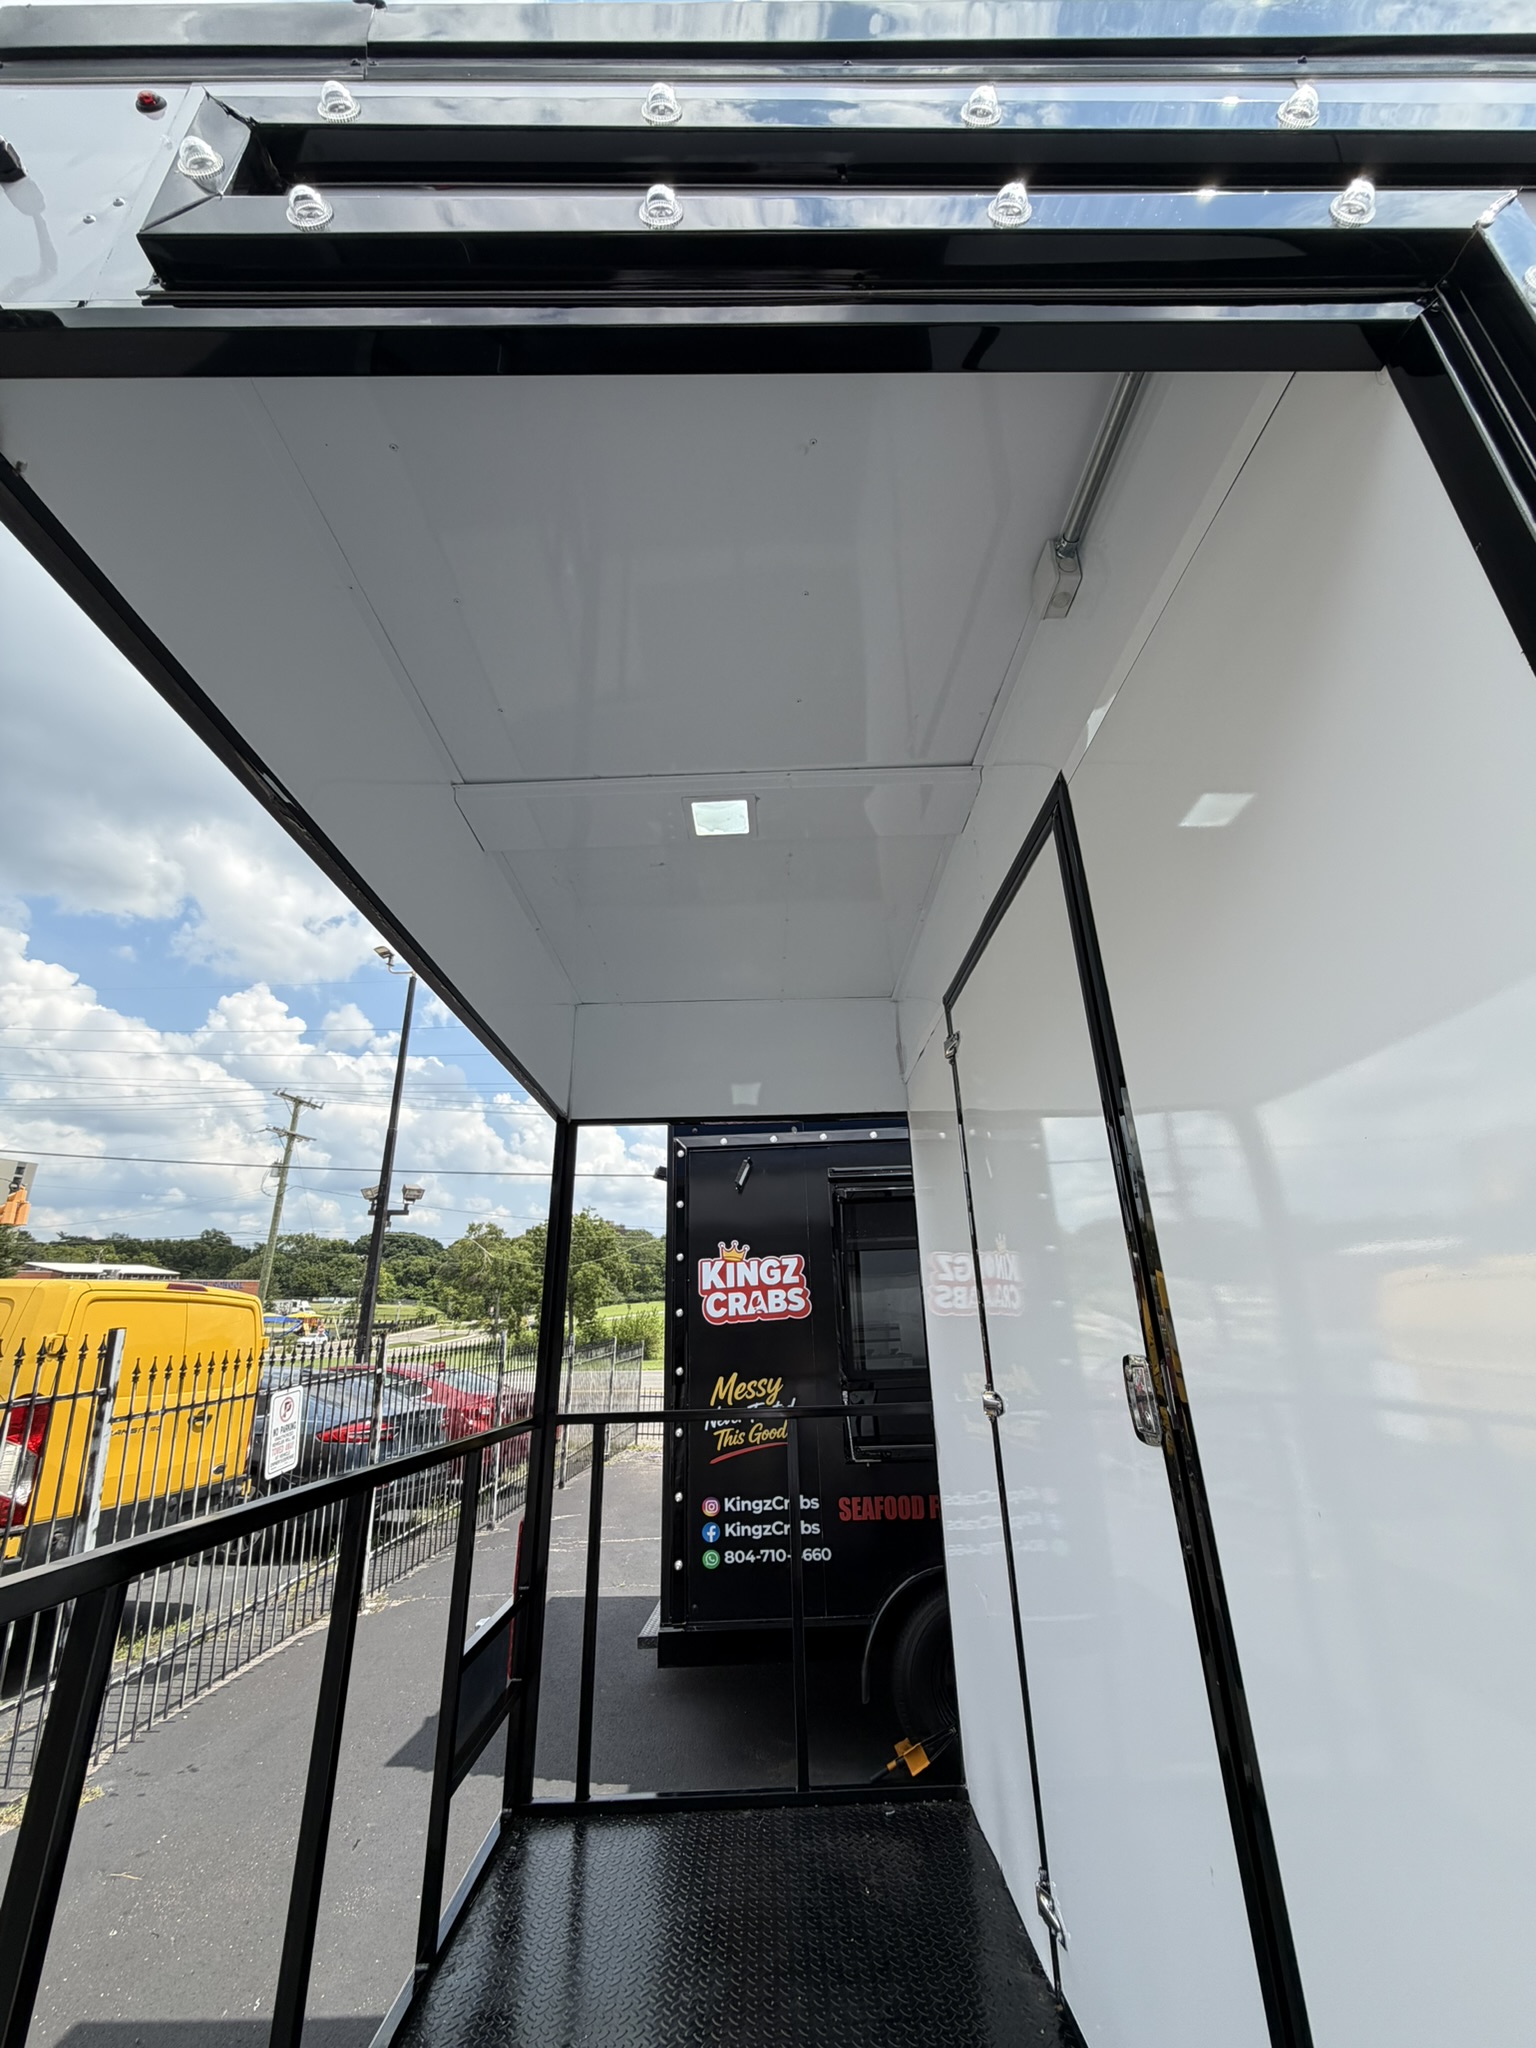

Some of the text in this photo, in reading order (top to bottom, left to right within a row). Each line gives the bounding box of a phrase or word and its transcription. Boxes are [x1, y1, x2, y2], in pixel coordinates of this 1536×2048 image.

[701, 1257, 800, 1290] KINGZ
[705, 1287, 806, 1318] CRABS
[709, 1372, 784, 1406] Messy
[713, 1419, 788, 1451] This Good
[724, 1495, 820, 1514] KingzCrbs
[838, 1495, 925, 1521] SEAFOOD
[724, 1520, 821, 1539] KingzCrbs
[724, 1547, 832, 1564] 804-710-660
